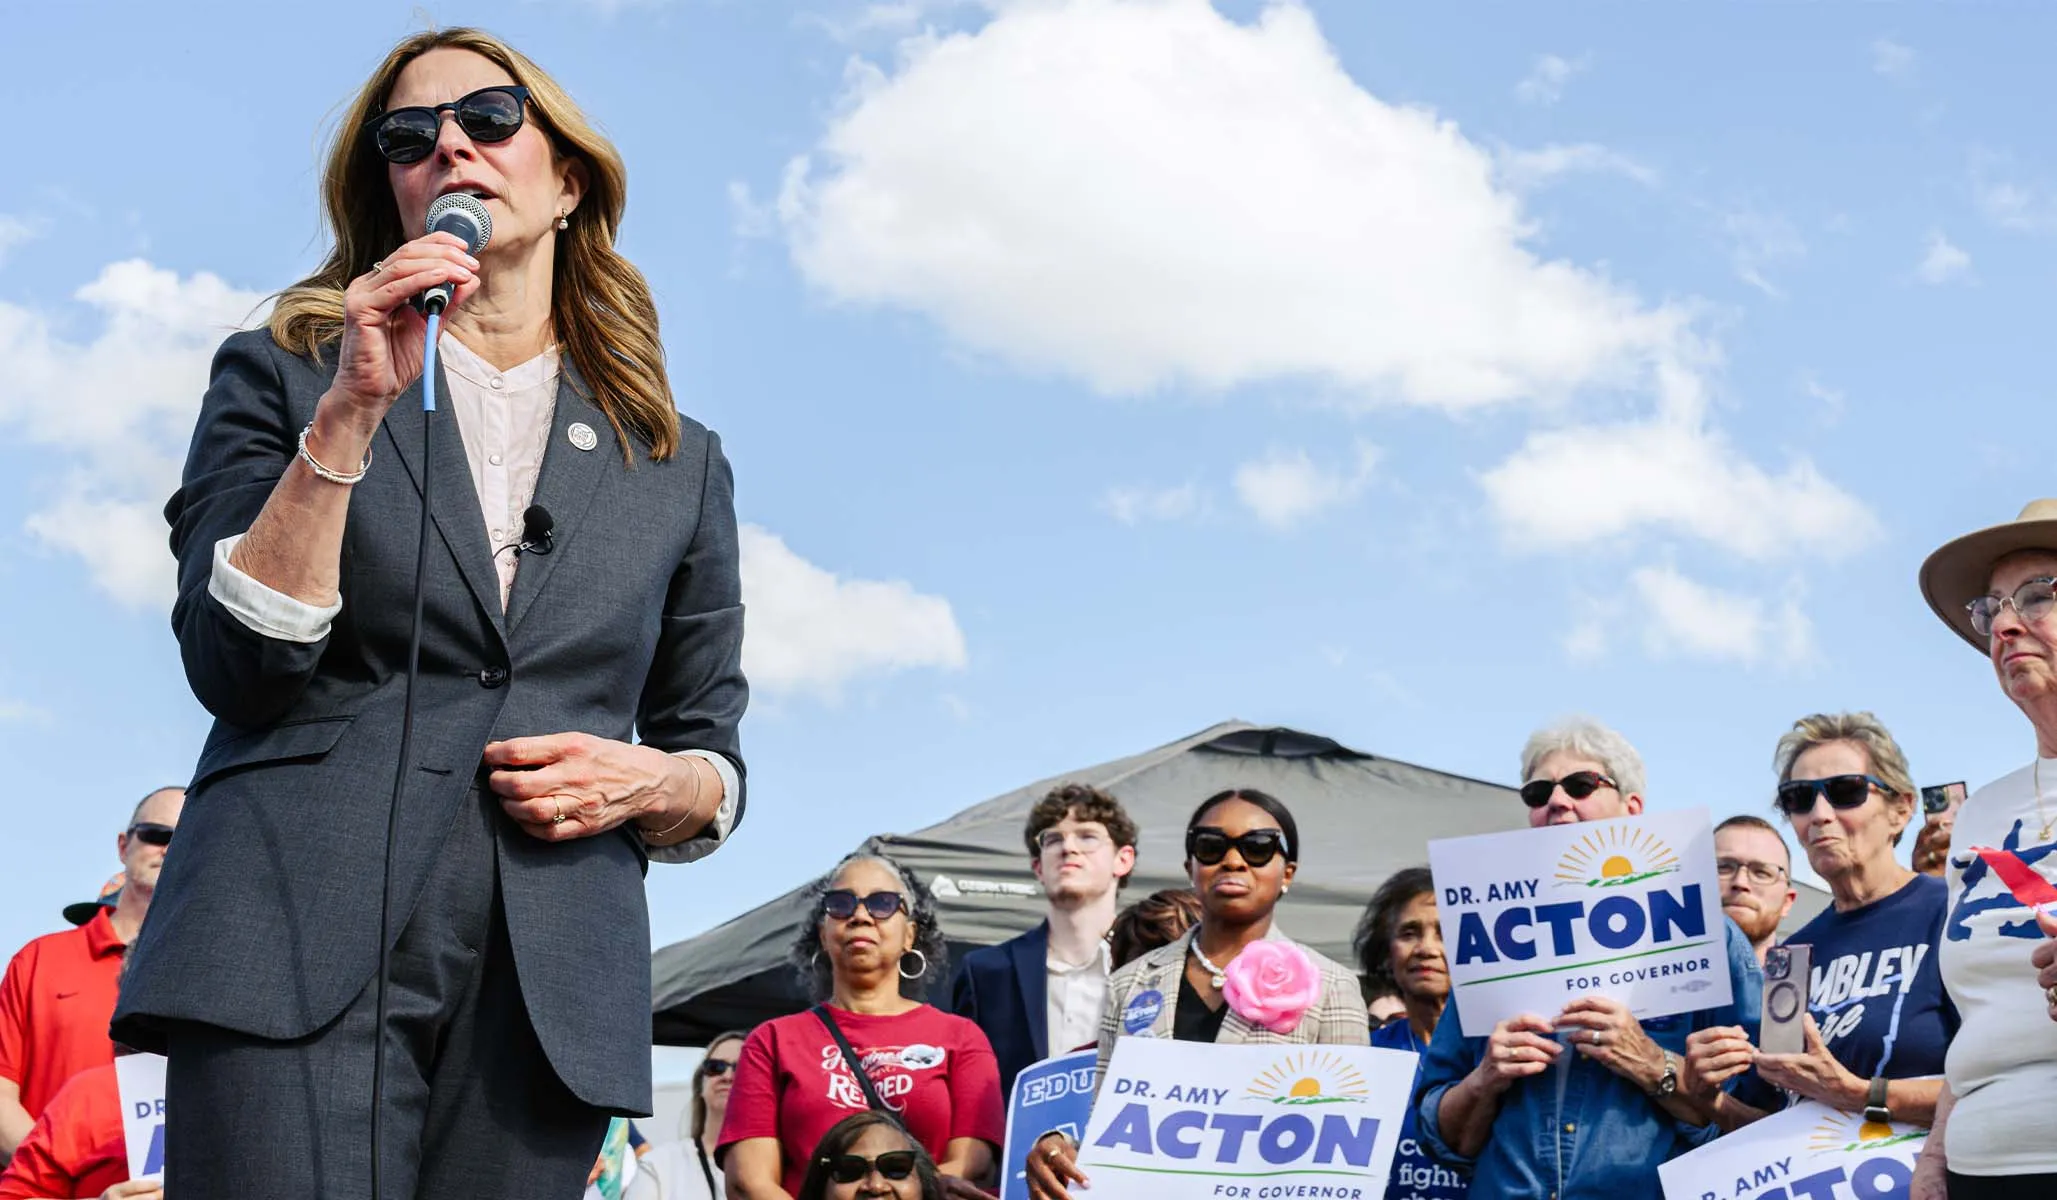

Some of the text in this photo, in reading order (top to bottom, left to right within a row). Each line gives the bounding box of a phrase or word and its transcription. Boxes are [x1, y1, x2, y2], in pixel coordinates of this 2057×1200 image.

[1445, 879, 1540, 906] DR. AMY
[1455, 883, 1706, 965] ACTON
[1566, 957, 1710, 991] FOR GOVERNOR
[826, 1072, 914, 1111] RERED
[1113, 1078, 1230, 1106] DR. AMY
[1093, 1102, 1381, 1168] ACTON
[1213, 1184, 1363, 1200] FOR GOVERNOR
[1735, 1156, 1792, 1196] AMY
